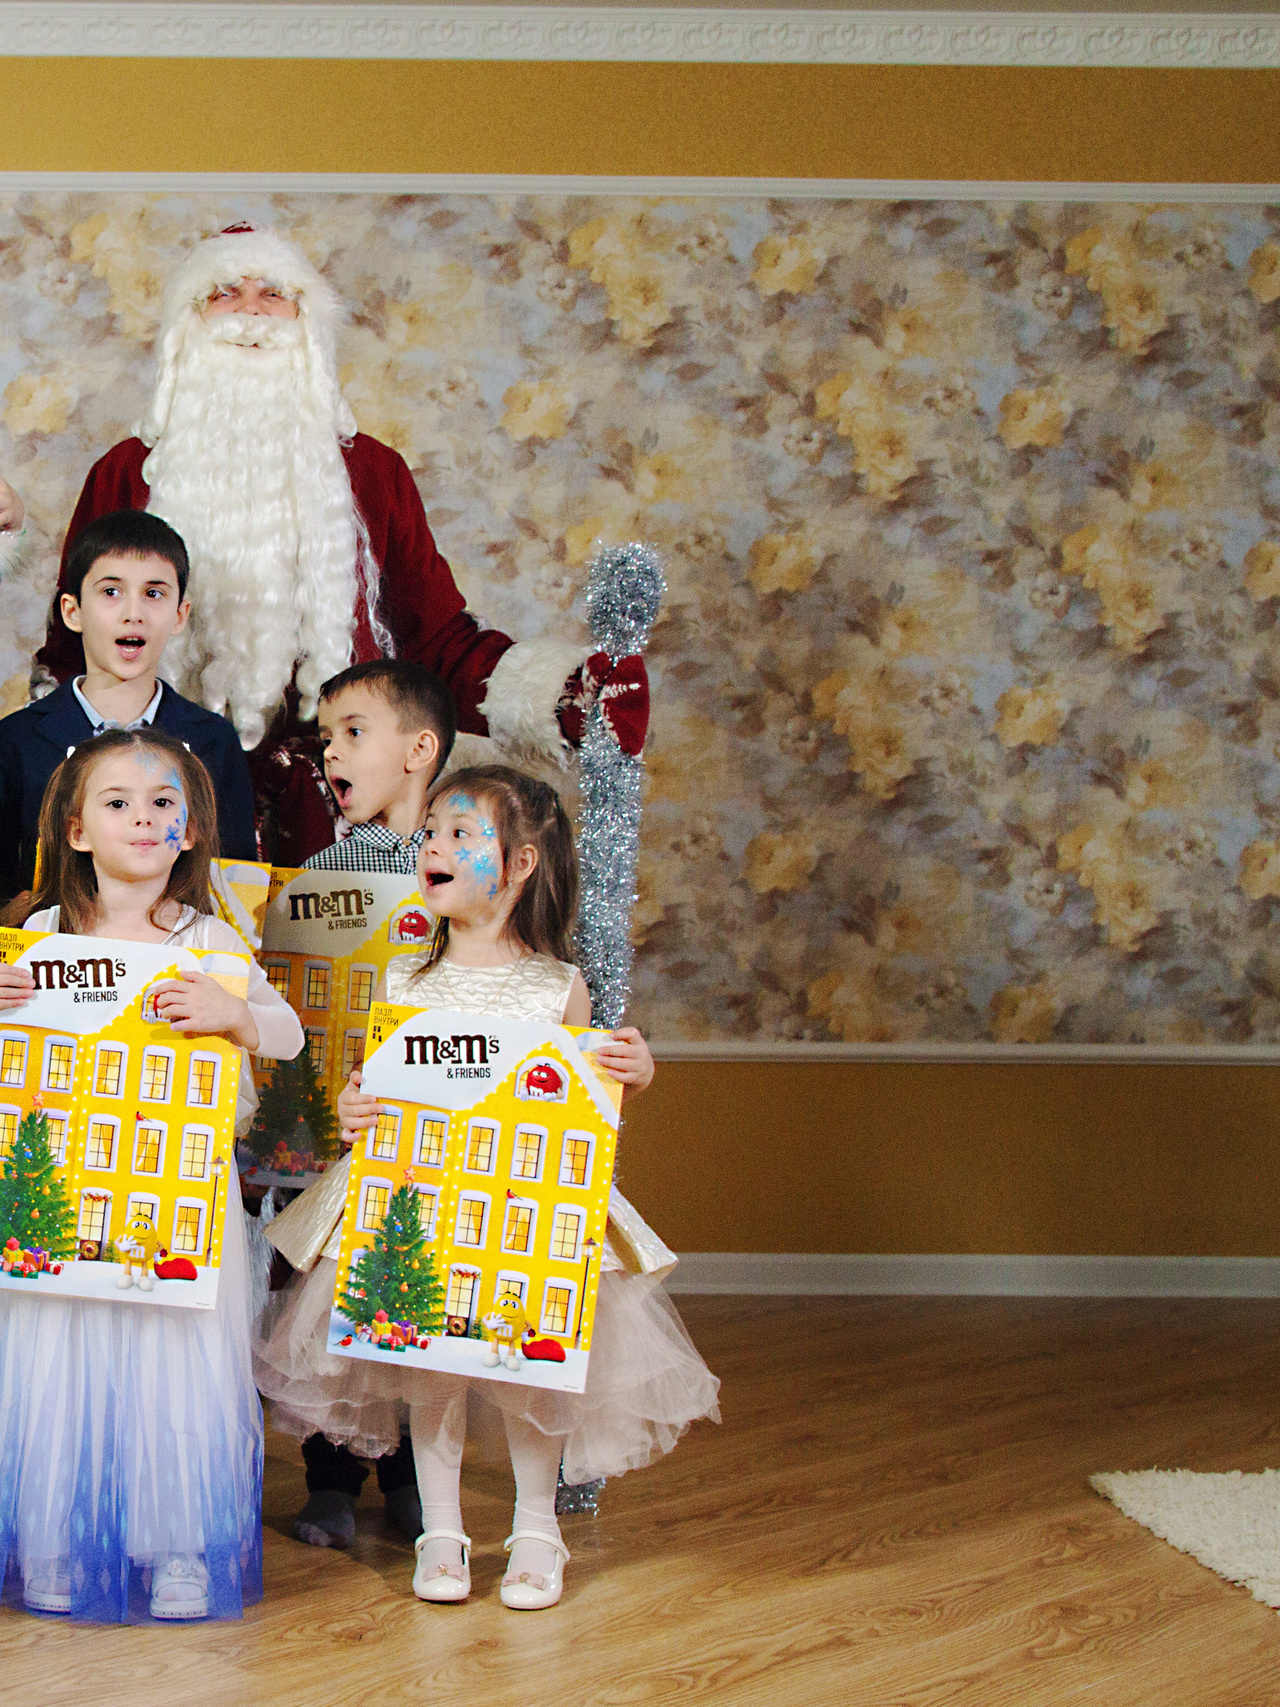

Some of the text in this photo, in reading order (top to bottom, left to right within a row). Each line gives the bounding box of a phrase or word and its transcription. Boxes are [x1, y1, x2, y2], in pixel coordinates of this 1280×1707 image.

[328, 918, 367, 930] & FRIENDS
[0, 932, 17, 941] ПАЗЛ
[0, 941, 24, 951] ВНУТРИ
[73, 991, 118, 1003] & FRIENDS
[375, 1007, 392, 1017] ПАЗЛ
[374, 1016, 399, 1026] ВНУТРИ
[447, 1067, 491, 1079] & FRIENDS
